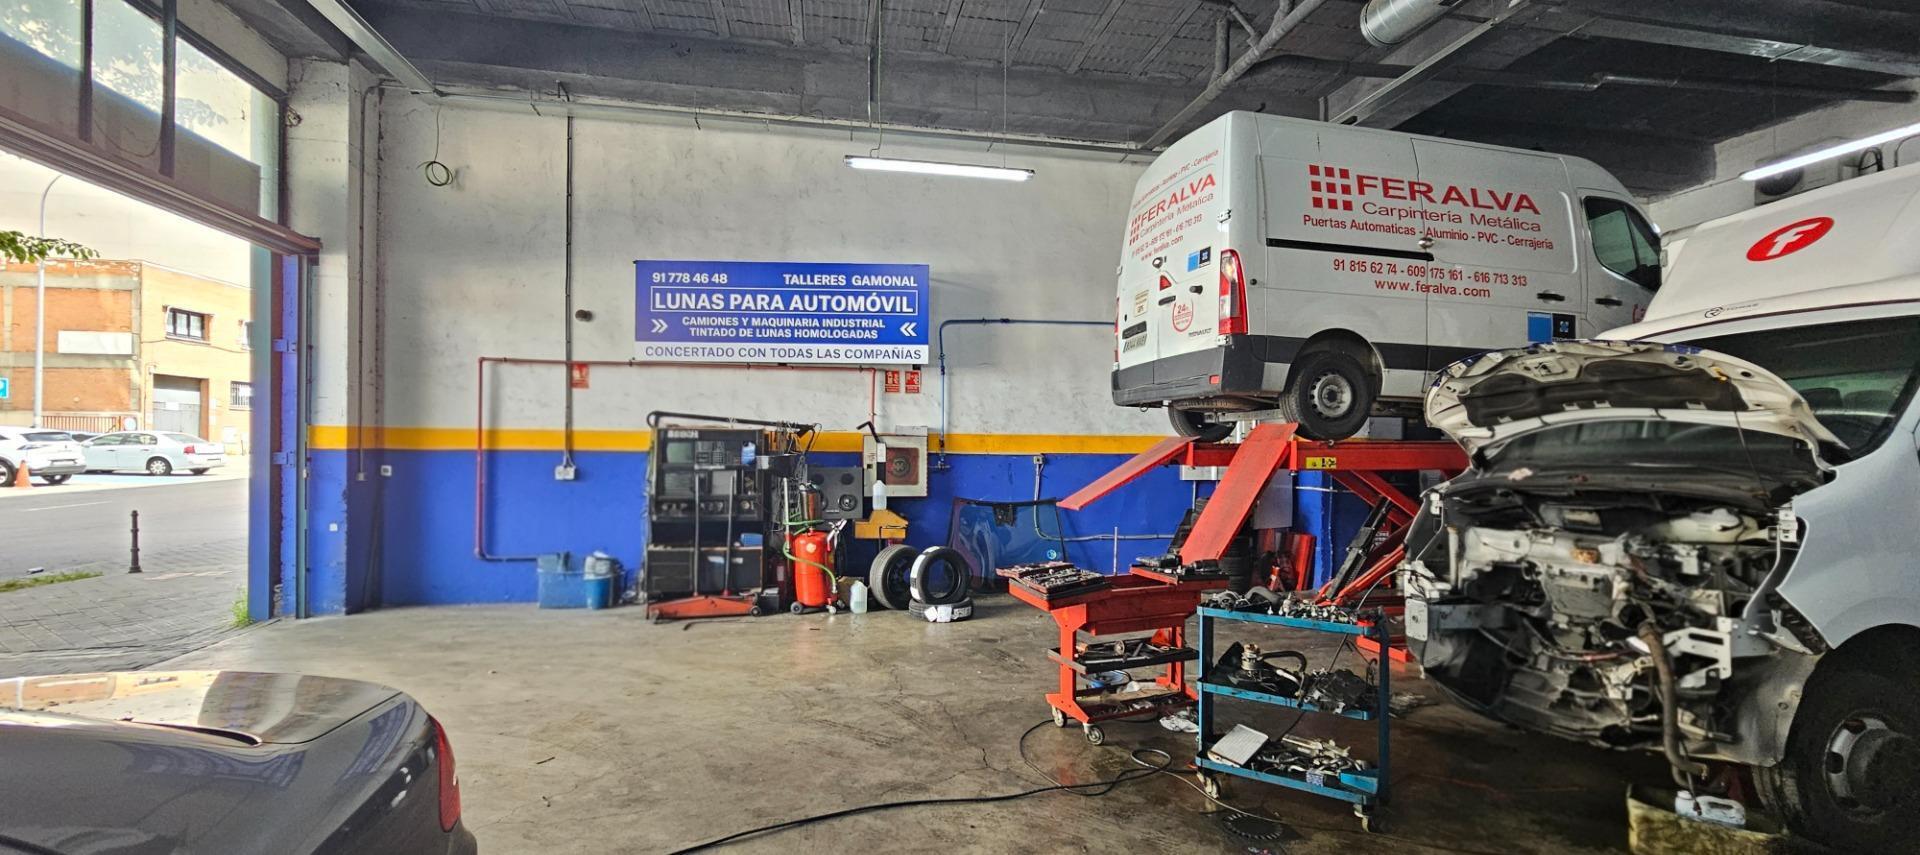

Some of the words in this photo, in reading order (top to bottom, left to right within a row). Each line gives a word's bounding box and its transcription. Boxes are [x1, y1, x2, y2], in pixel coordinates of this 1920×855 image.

[1139, 173, 1217, 228] FERALVA
[1356, 174, 1541, 215] FERALVA
[1362, 201, 1462, 224] Carpintería
[1470, 213, 1541, 232] Metálica
[1303, 214, 1347, 229] Puertas
[1350, 219, 1416, 236] Automaticas
[1425, 227, 1468, 241] Aluminio
[1477, 231, 1498, 244] PVC
[652, 272, 665, 283] 91
[668, 272, 690, 283] 778
[692, 273, 709, 284] 46
[711, 273, 728, 284] 48
[783, 274, 847, 286] TALLERES
[852, 275, 918, 287] GAMONAL
[1333, 258, 1345, 271] 91
[1349, 260, 1367, 273] 815
[1370, 261, 1383, 274] 62
[1386, 263, 1397, 275] 74
[1407, 265, 1426, 277] 609
[1429, 267, 1445, 279] 175
[1448, 269, 1463, 281] 161
[1474, 271, 1490, 283] 616
[1493, 272, 1509, 285] 713
[1511, 274, 1528, 287] 313
[1375, 280, 1491, 298] www.feralva.com
[655, 292, 725, 310] LUNAS
[730, 294, 785, 311] PARA
[789, 292, 914, 313] AUTOMÓVIL
[682, 316, 739, 326] CAMIONES
[741, 317, 749, 326] Y
[751, 317, 820, 327] MAQUINARIA
[822, 318, 886, 328] INDUSTRIAL
[689, 327, 736, 337] TINTADO
[739, 328, 754, 337] DE
[756, 328, 792, 338] LUNAS
[794, 329, 878, 339] HOMOLOGADAS
[645, 345, 735, 357] CONCERTADO
[738, 347, 766, 358] CON
[770, 347, 813, 358] TODAS
[817, 348, 841, 359] LAS
[844, 346, 921, 360] COMPAÑÍAS
